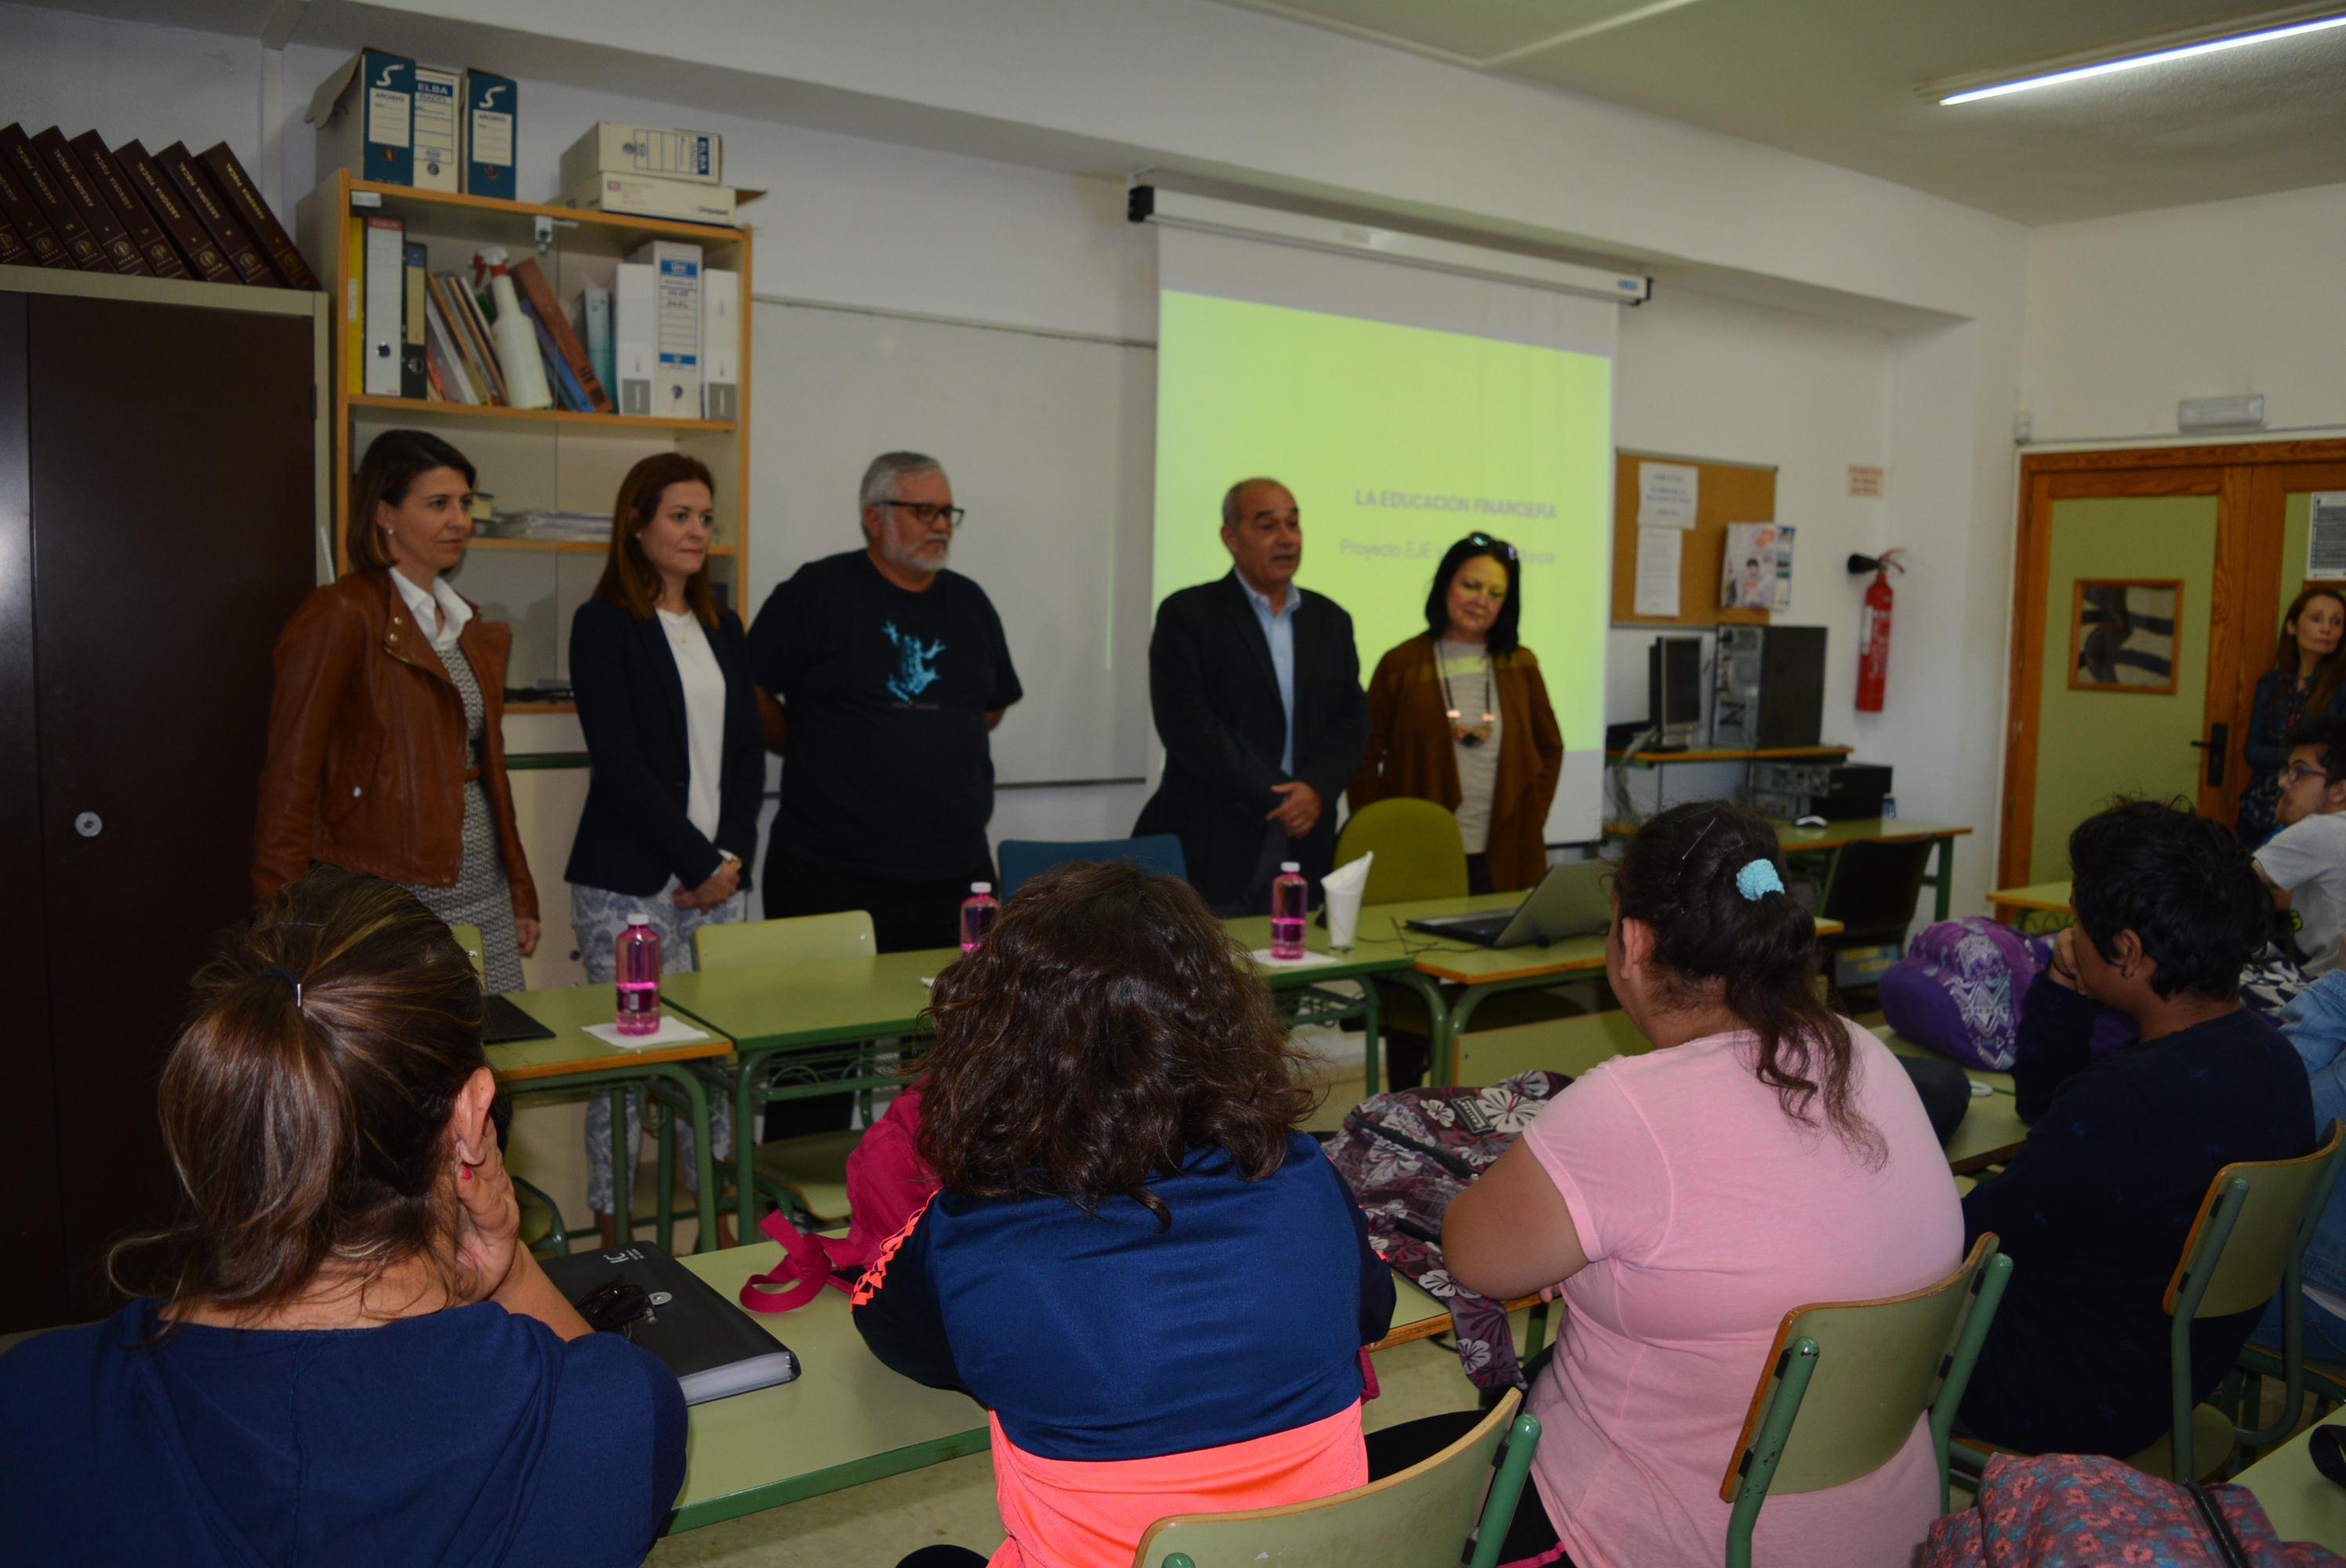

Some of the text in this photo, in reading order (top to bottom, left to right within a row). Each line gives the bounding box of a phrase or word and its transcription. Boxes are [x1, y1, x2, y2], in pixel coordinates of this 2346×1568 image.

[417, 82, 449, 95] ELBA
[14, 143, 57, 205] ASESORIA FISCAL
[52, 147, 95, 208] ASESORIA FISCAL
[91, 150, 133, 210] ASESORIA FISCAL
[136, 161, 180, 220] ASESORIA FISCAL
[177, 161, 220, 220] ASESORIA FISCAL
[223, 162, 266, 221] ASESORIA FISCAL
[1355, 488, 1557, 519] LA EDUCACIÓN FINANCIERA
[1340, 537, 1403, 561] Proyecto
[1405, 539, 1434, 560] EJE
